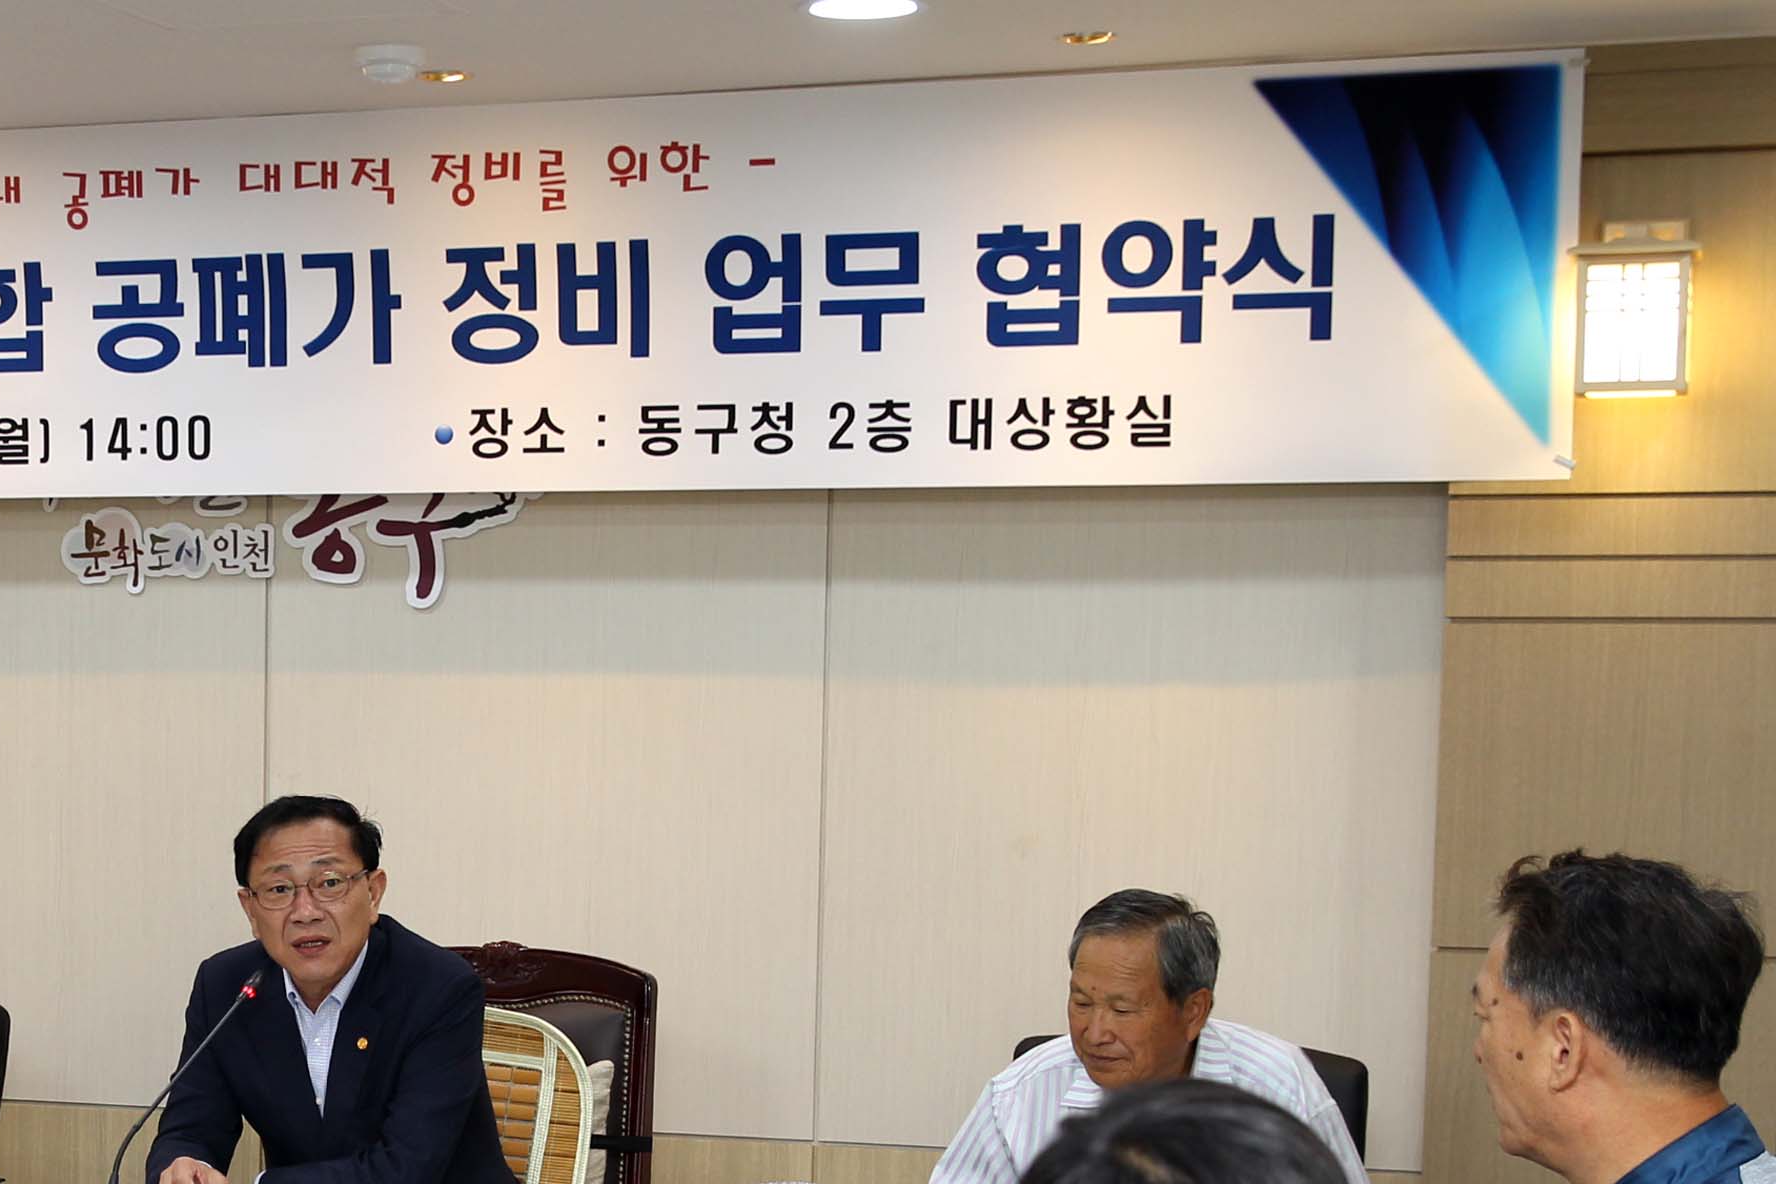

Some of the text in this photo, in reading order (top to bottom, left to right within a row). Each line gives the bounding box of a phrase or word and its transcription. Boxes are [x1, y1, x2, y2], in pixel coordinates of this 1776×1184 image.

[62, 167, 199, 232] 공폐가
[237, 157, 397, 206] 대대적
[430, 149, 569, 213] 정비를
[606, 141, 711, 194] 위한
[90, 248, 402, 374] 공폐가
[442, 238, 650, 365] 정비
[704, 231, 925, 355] 업무
[976, 213, 1335, 348] 협약식
[79, 414, 212, 462] 14:00
[468, 407, 566, 459] 장소
[637, 401, 795, 458] 동구청
[827, 399, 913, 453] 2층
[947, 394, 1174, 451] 대상황실
[71, 519, 272, 588] 문화도시 인천
